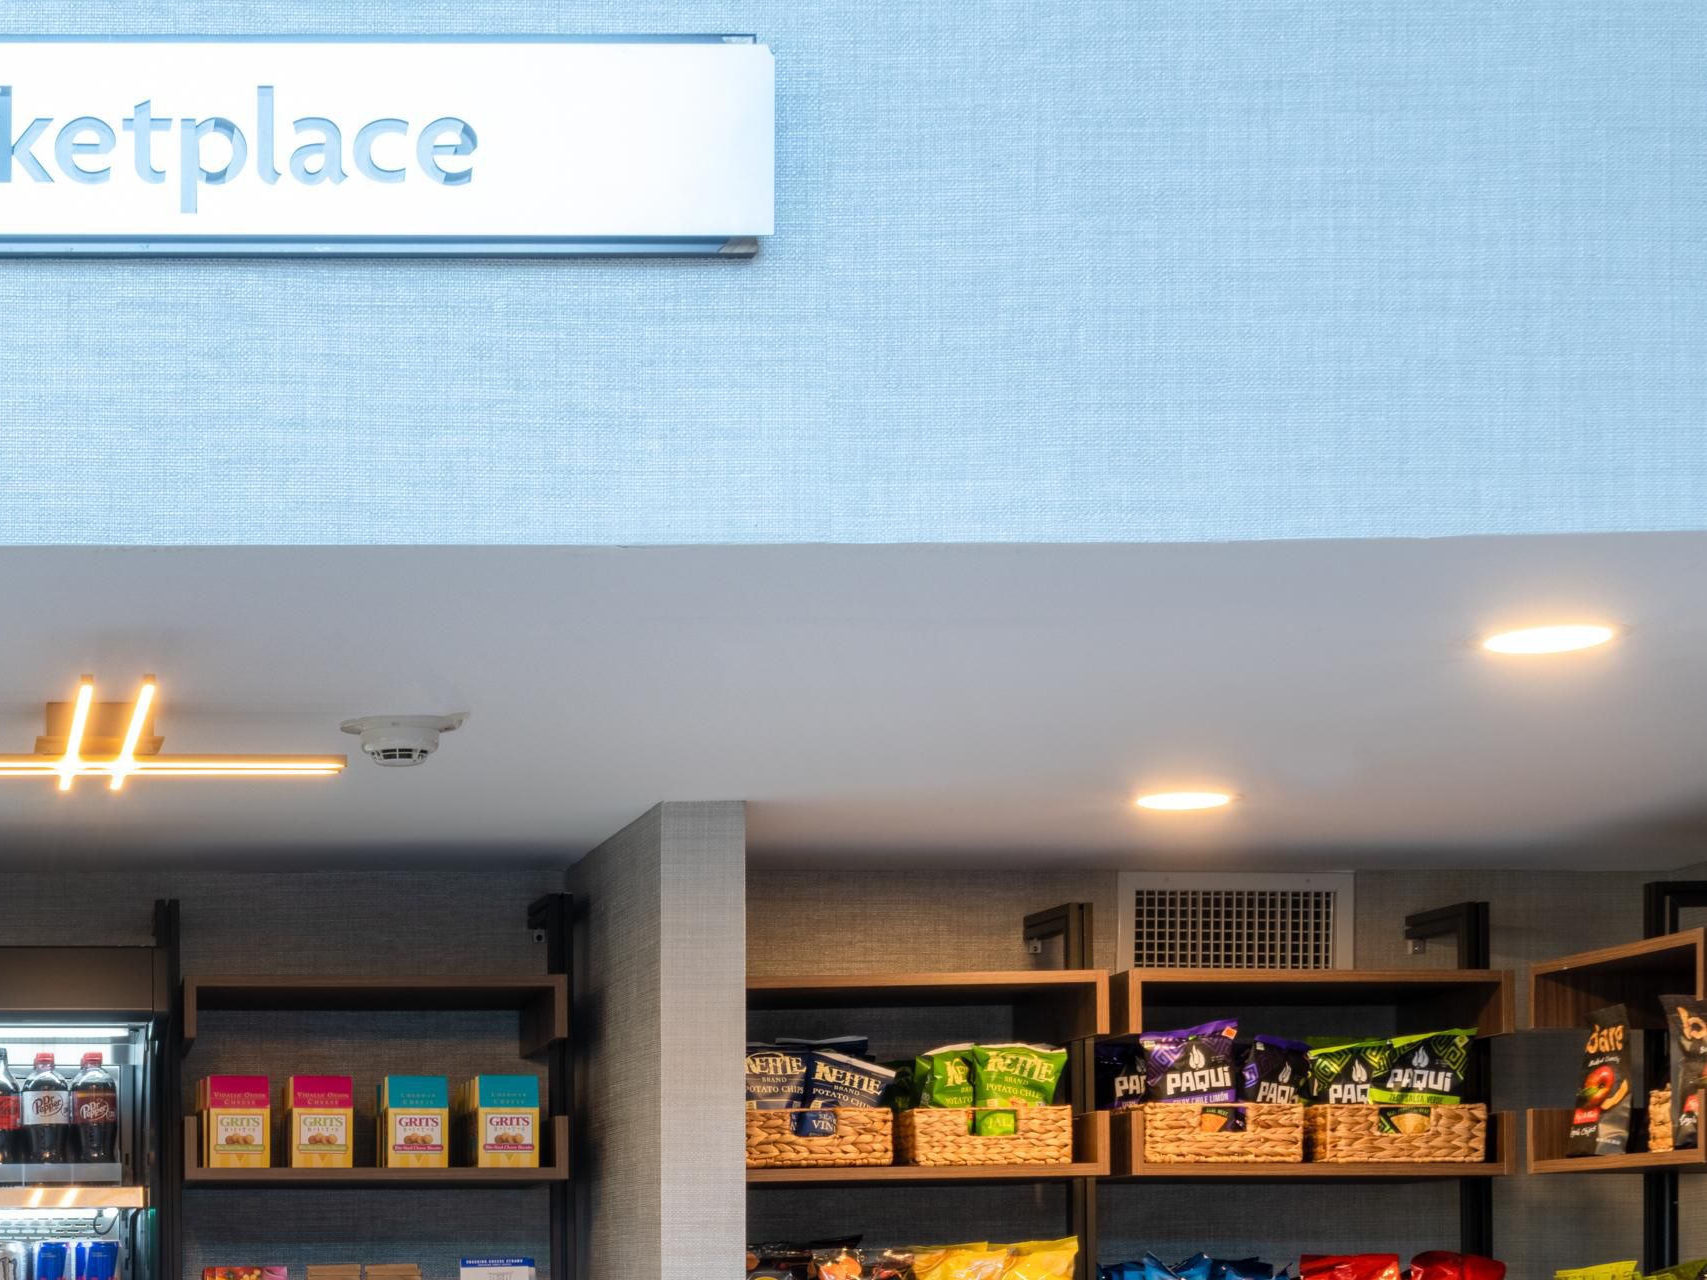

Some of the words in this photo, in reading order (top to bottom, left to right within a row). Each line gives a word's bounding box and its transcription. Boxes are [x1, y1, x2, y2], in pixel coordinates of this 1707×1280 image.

[982, 1050, 1056, 1082] KETTLE
[810, 1060, 884, 1096] KETTLE
[1003, 1075, 1030, 1086] BRAND
[746, 1085, 780, 1094] OTATO
[812, 1086, 850, 1103] POTATO
[832, 1084, 861, 1097] BRAND
[985, 1082, 1019, 1095] POTATO
[34, 1099, 63, 1116] Pepper
[80, 1103, 109, 1120] Pepper
[219, 1116, 261, 1127] GRITS
[302, 1116, 344, 1127] GRITS
[398, 1117, 440, 1127] GRITS
[488, 1116, 530, 1126] GRITS
